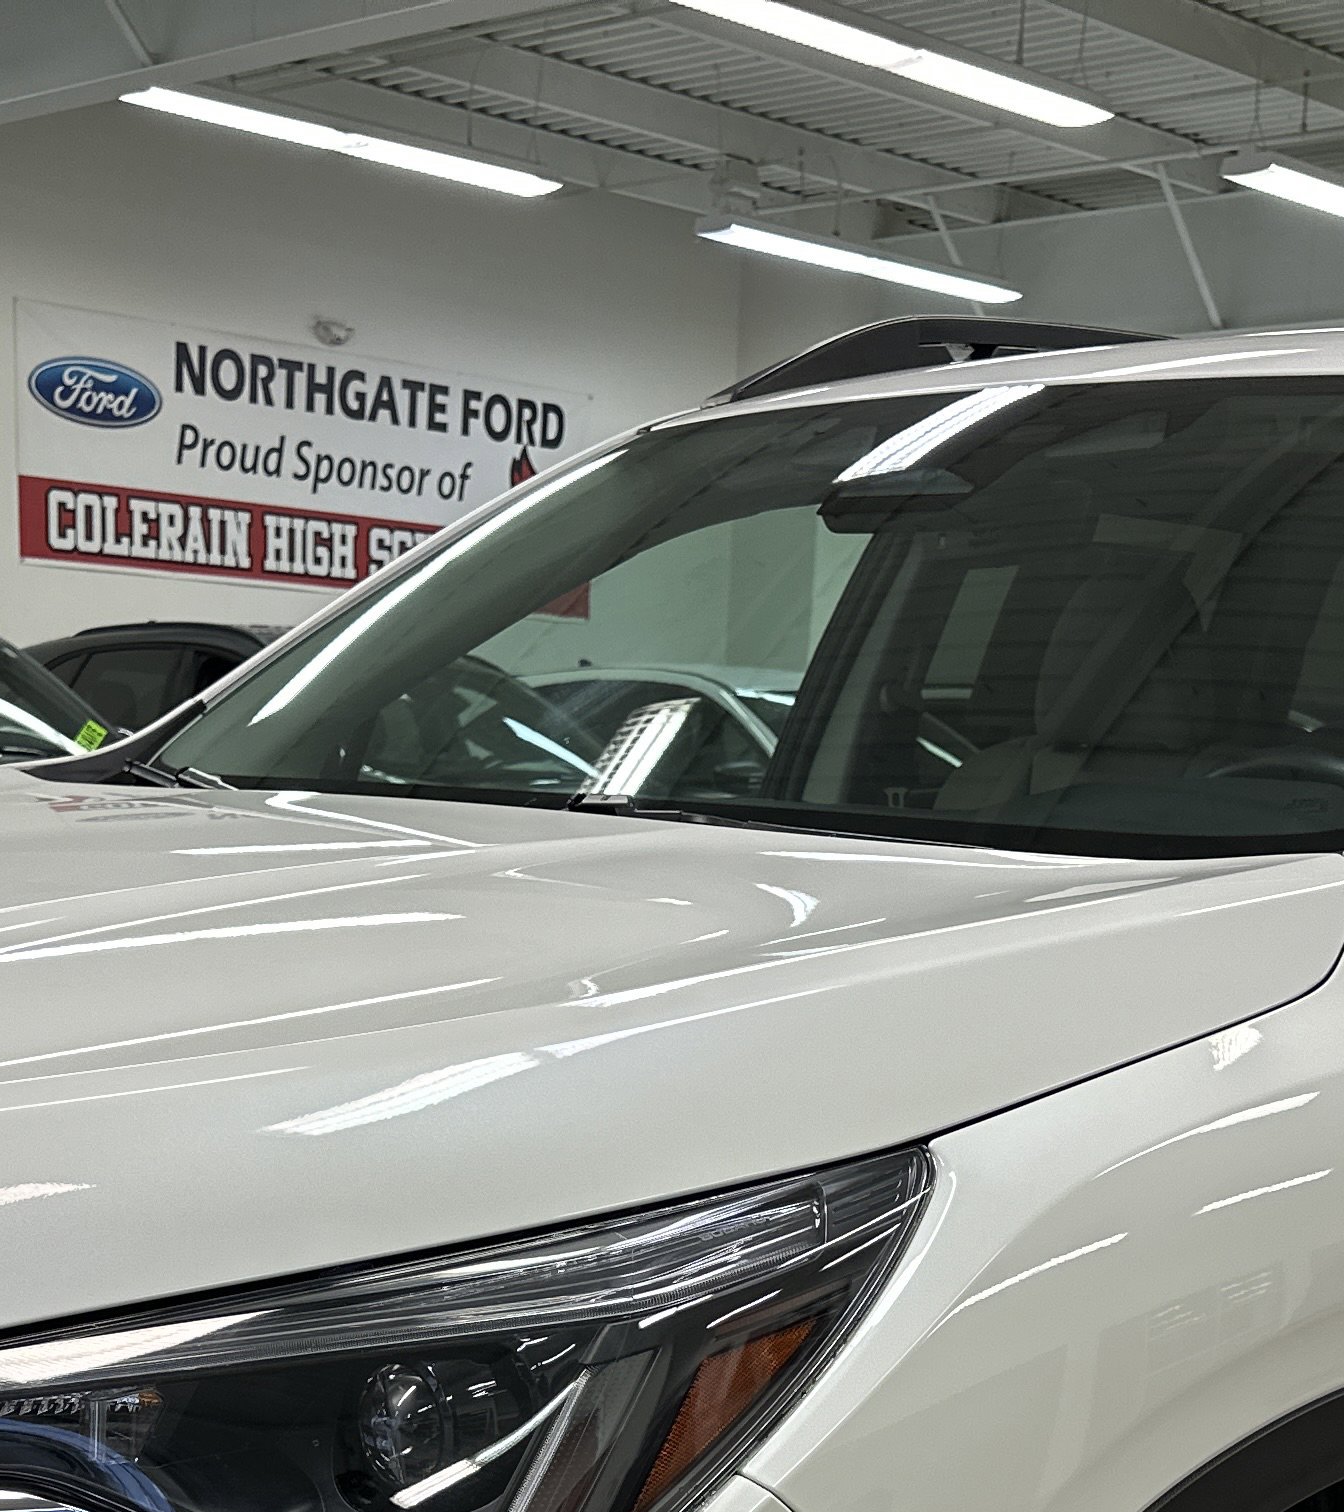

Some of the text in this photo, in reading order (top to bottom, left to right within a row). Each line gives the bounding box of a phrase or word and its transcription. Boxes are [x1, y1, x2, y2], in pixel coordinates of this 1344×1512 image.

[173, 341, 565, 451] NORTHGATE FORD
[175, 424, 473, 502] Proud Sponsor of
[46, 487, 252, 570] COLERAIN
[262, 517, 358, 580] HIGH
